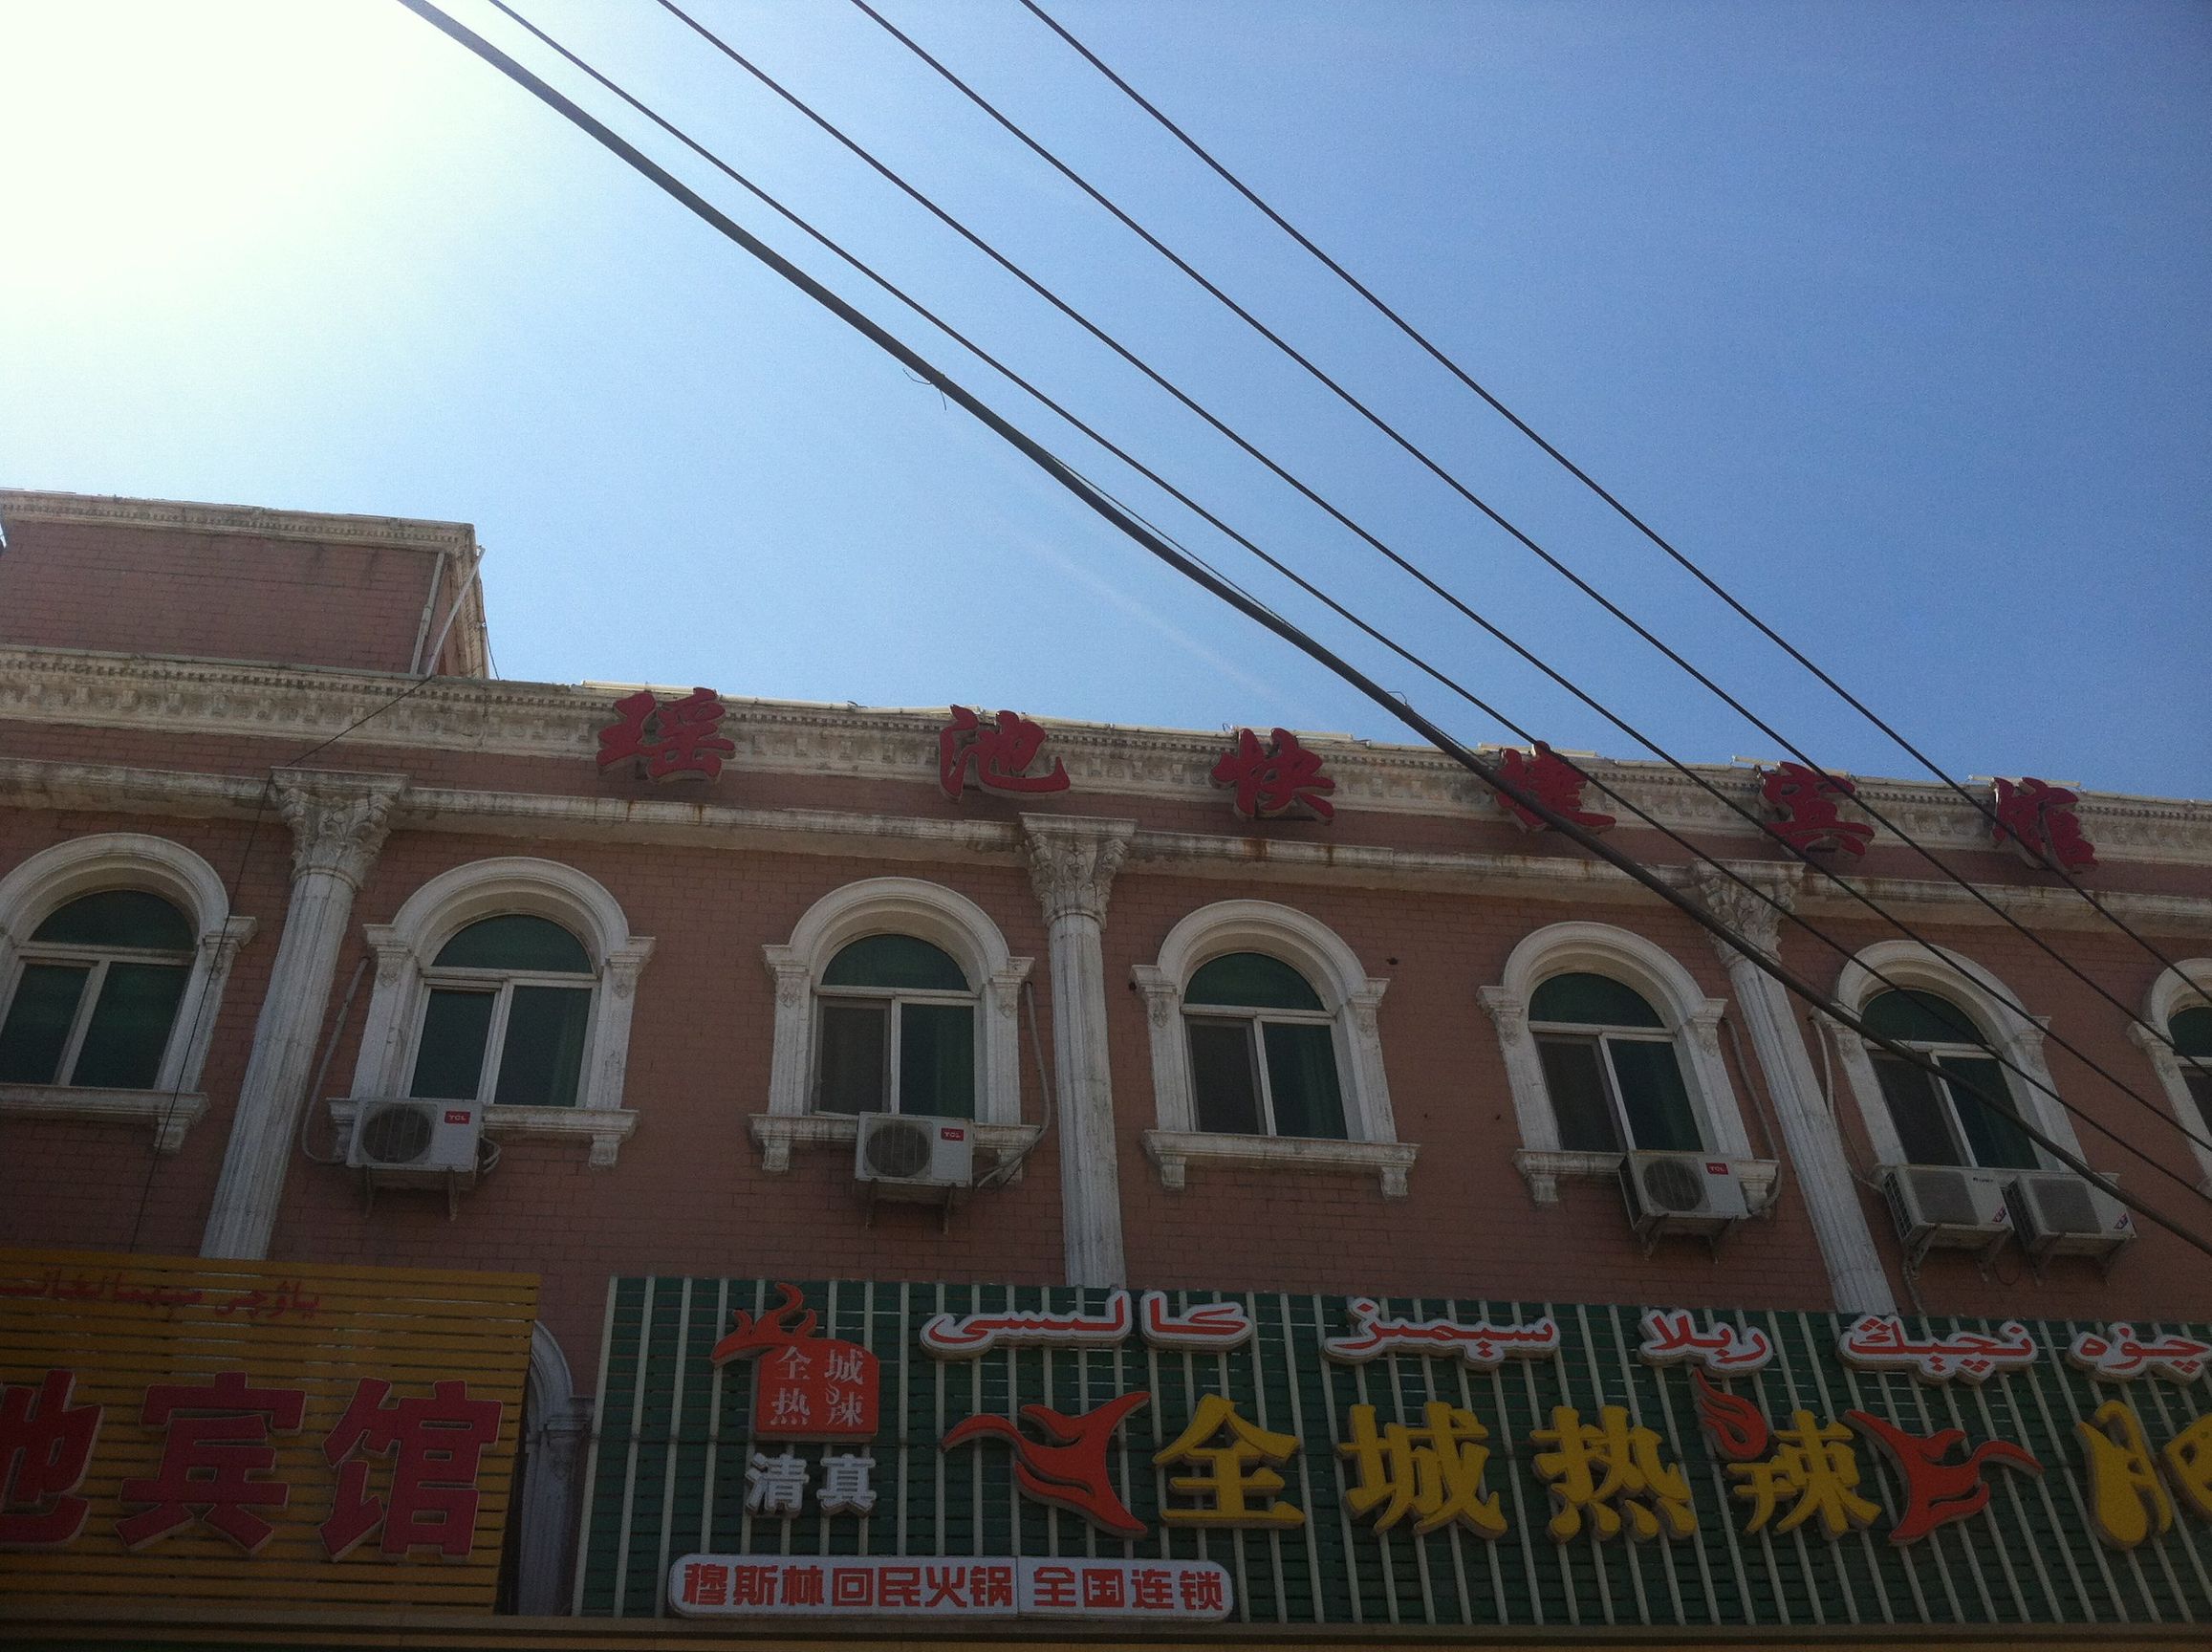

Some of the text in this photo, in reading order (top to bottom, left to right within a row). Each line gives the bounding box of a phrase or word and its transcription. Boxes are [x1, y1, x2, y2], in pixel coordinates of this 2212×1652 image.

[775, 1345, 865, 1385] 全城
[770, 1386, 864, 1428] 热辣
[745, 1454, 877, 1514] 清真
[683, 1562, 1225, 1612] 穆斯林回民火锅 全国连锁
